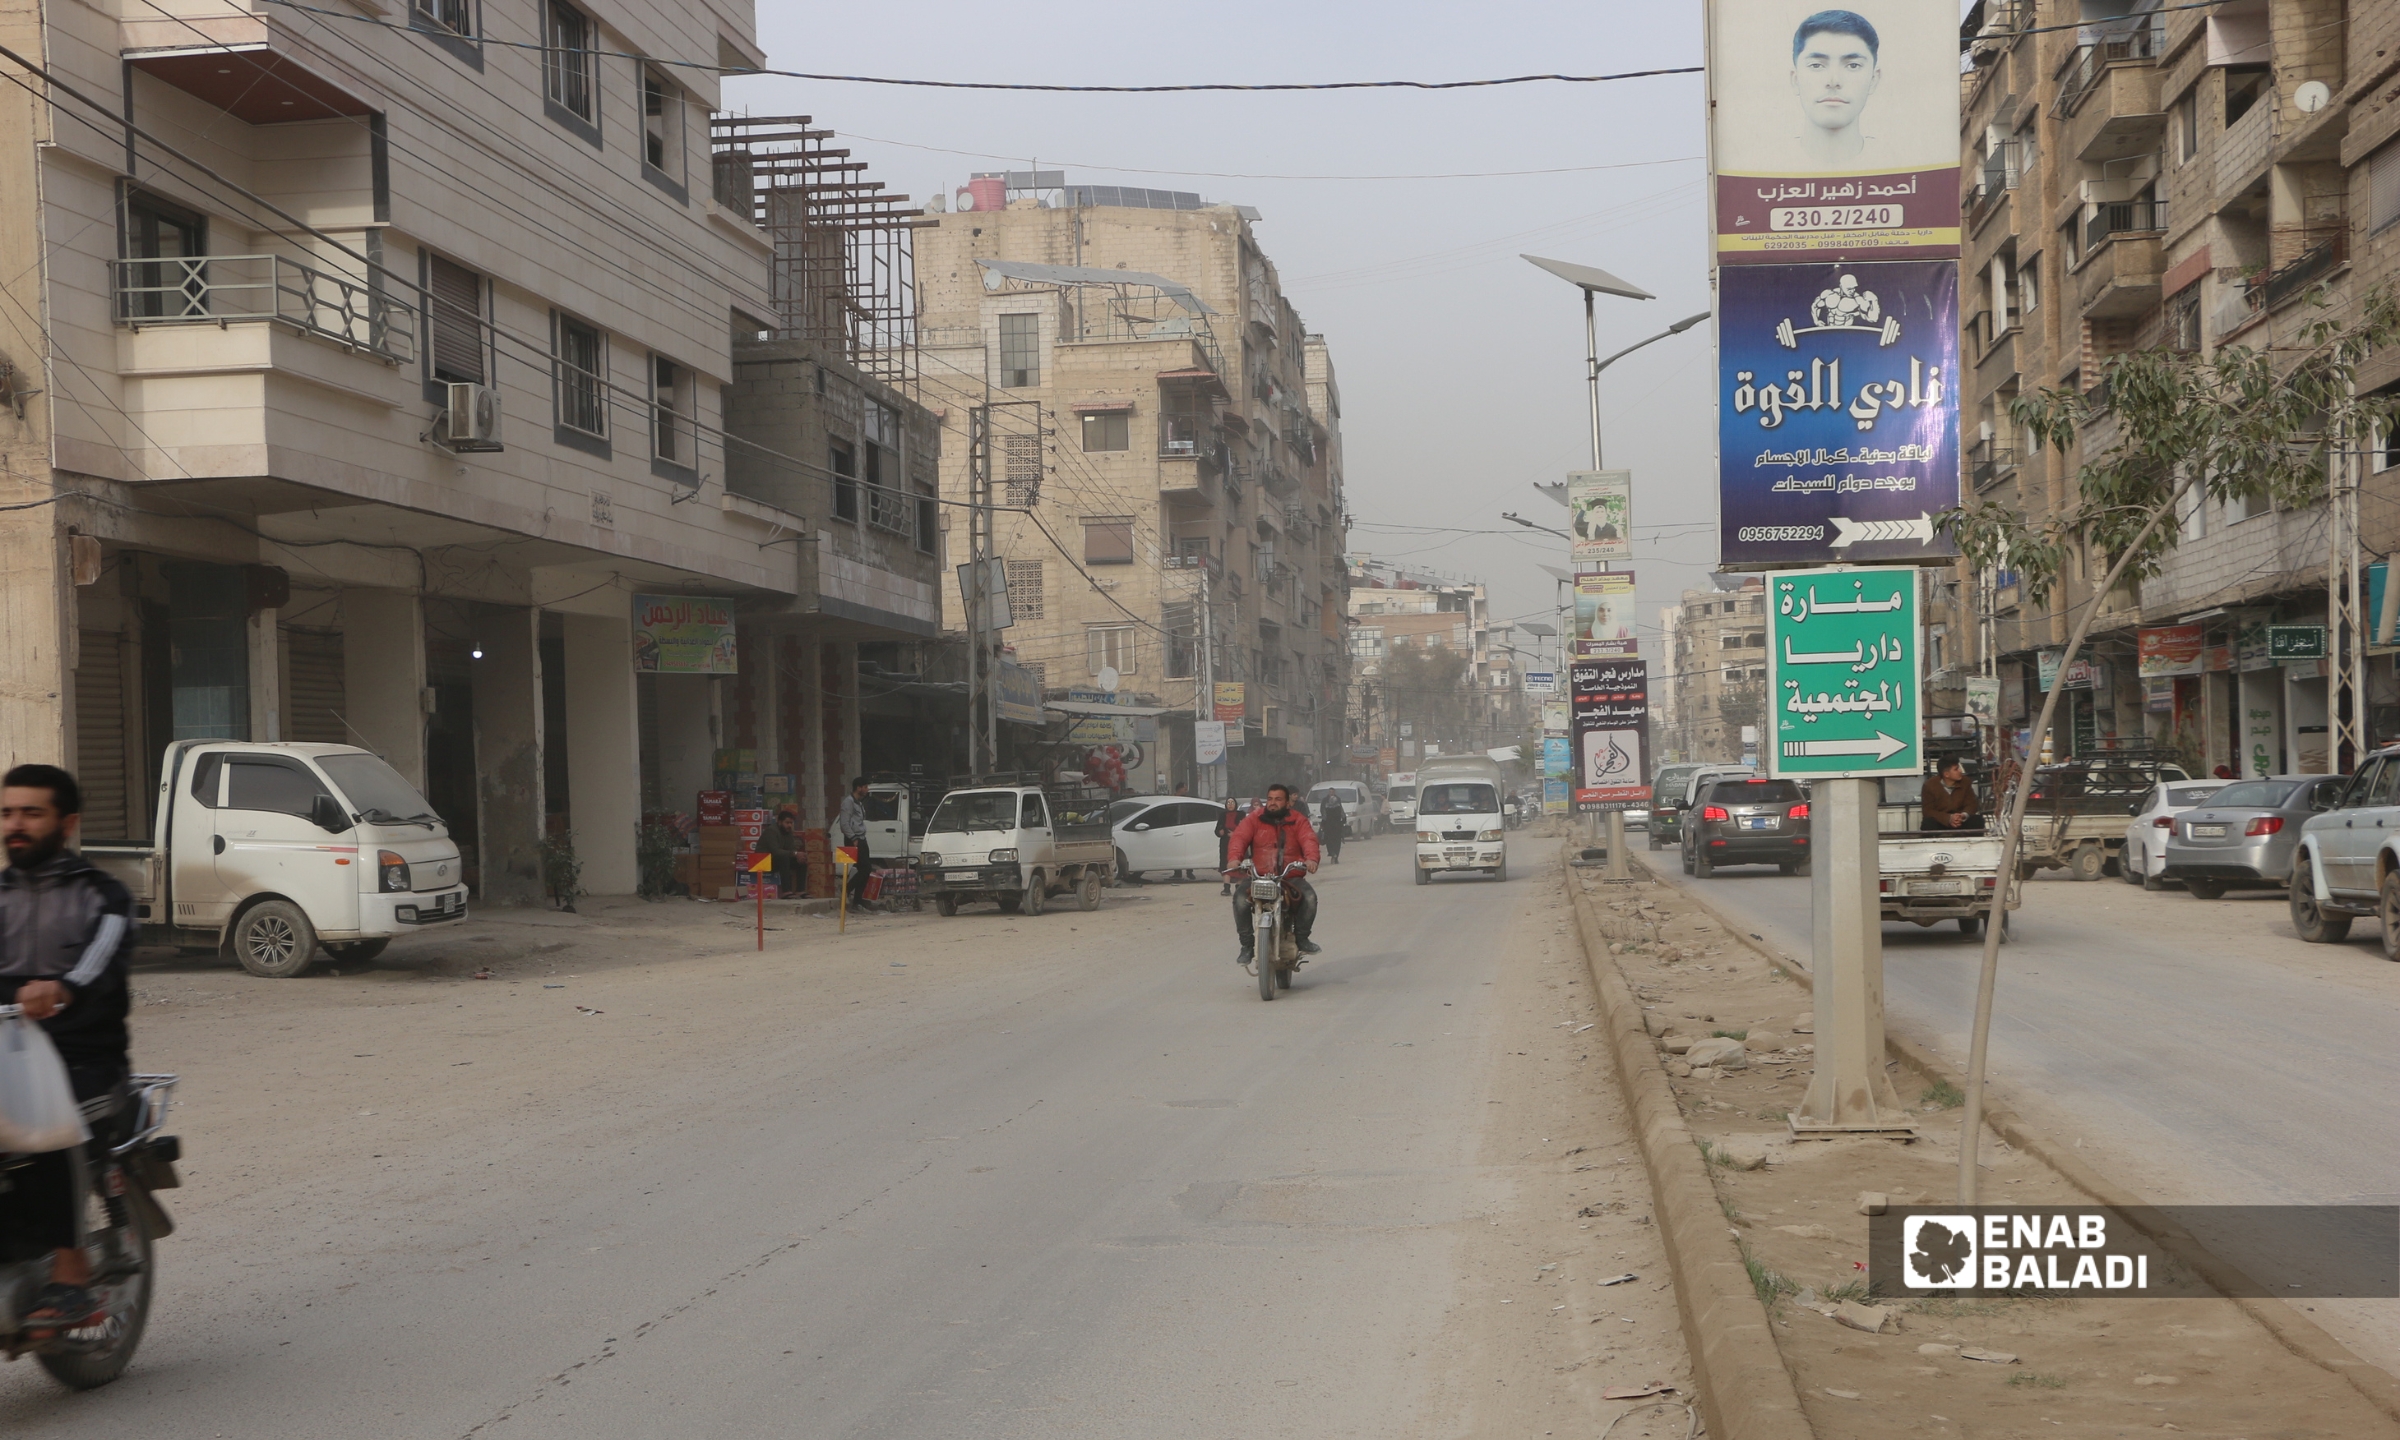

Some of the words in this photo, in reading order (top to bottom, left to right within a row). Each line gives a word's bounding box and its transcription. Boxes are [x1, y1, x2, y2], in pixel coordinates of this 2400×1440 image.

[1757, 182, 1816, 202] العزب
[1819, 181, 1863, 201] زهير
[1867, 174, 1917, 196] أحمد
[1783, 207, 1891, 227] 230.2/240
[1764, 241, 1807, 250] 6292035
[1817, 239, 1879, 248] 0998407609
[1734, 356, 1841, 428] القوة
[1849, 355, 1943, 430] نادي
[1811, 447, 1848, 466] كمال
[1772, 474, 1836, 494] للسيدات
[1837, 473, 1873, 494] دوام
[1874, 475, 1916, 491] يوجد
[1738, 525, 1824, 542] 0956752294
[1779, 579, 1902, 623] منارة
[641, 601, 692, 630] الرحمن
[697, 603, 729, 633] عباد
[1784, 632, 1902, 673] داريا
[1599, 667, 1617, 682] فجر
[1618, 667, 1645, 681] مدارس
[1784, 679, 1902, 723] المجتمعية
[1575, 704, 1611, 719] الفجر
[1612, 706, 1645, 717] معهد
